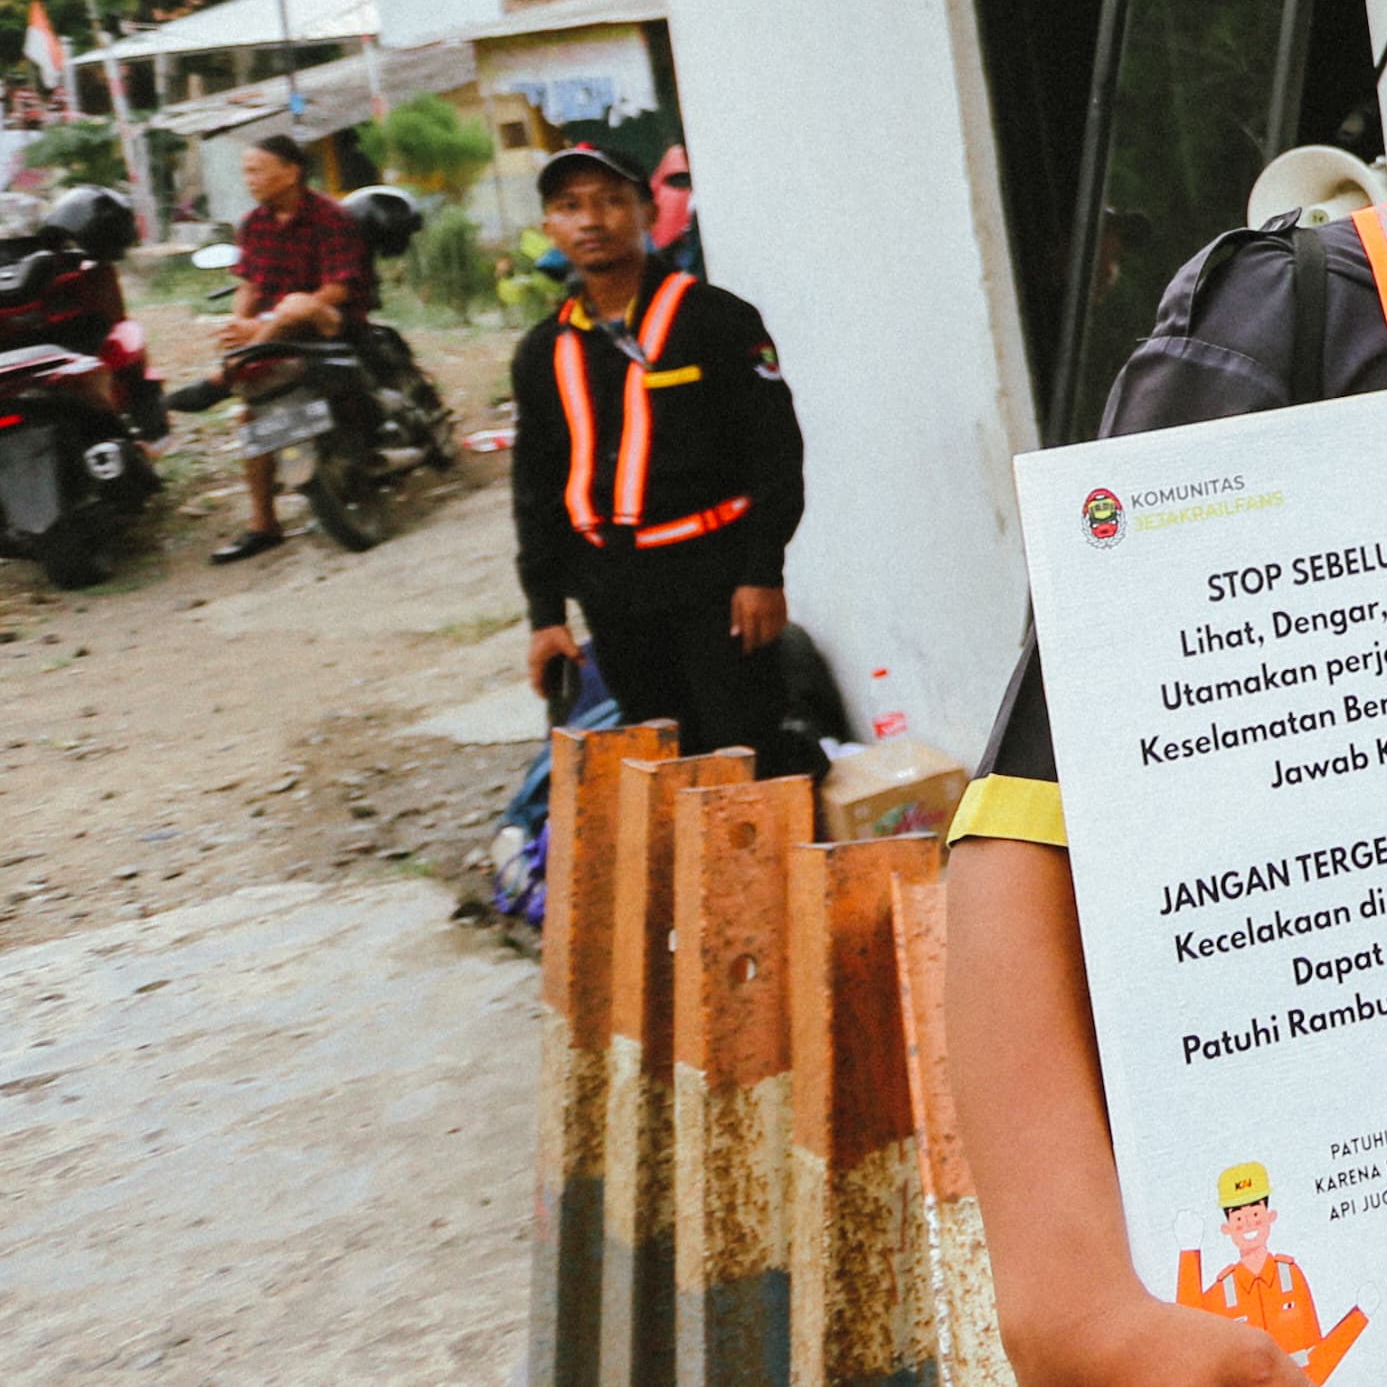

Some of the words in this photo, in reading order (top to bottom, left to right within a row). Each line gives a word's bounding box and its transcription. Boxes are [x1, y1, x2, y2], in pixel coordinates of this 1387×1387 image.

[1131, 475, 1245, 509] KOMUNITAS
[1207, 562, 1283, 603] STOP
[1179, 620, 1265, 658] Lihat,
[1160, 661, 1318, 711] Utamakan
[1139, 709, 1337, 767] Keselamatan
[1270, 741, 1370, 790] Jawab
[1159, 858, 1291, 917] JANGAN
[1174, 905, 1352, 964] Kecelakaan
[1359, 886, 1387, 920] di
[1291, 941, 1385, 987] Dapat
[1181, 1013, 1281, 1066] Patuhi
[1314, 1163, 1382, 1195] KARENA
[1329, 1199, 1357, 1222] API
